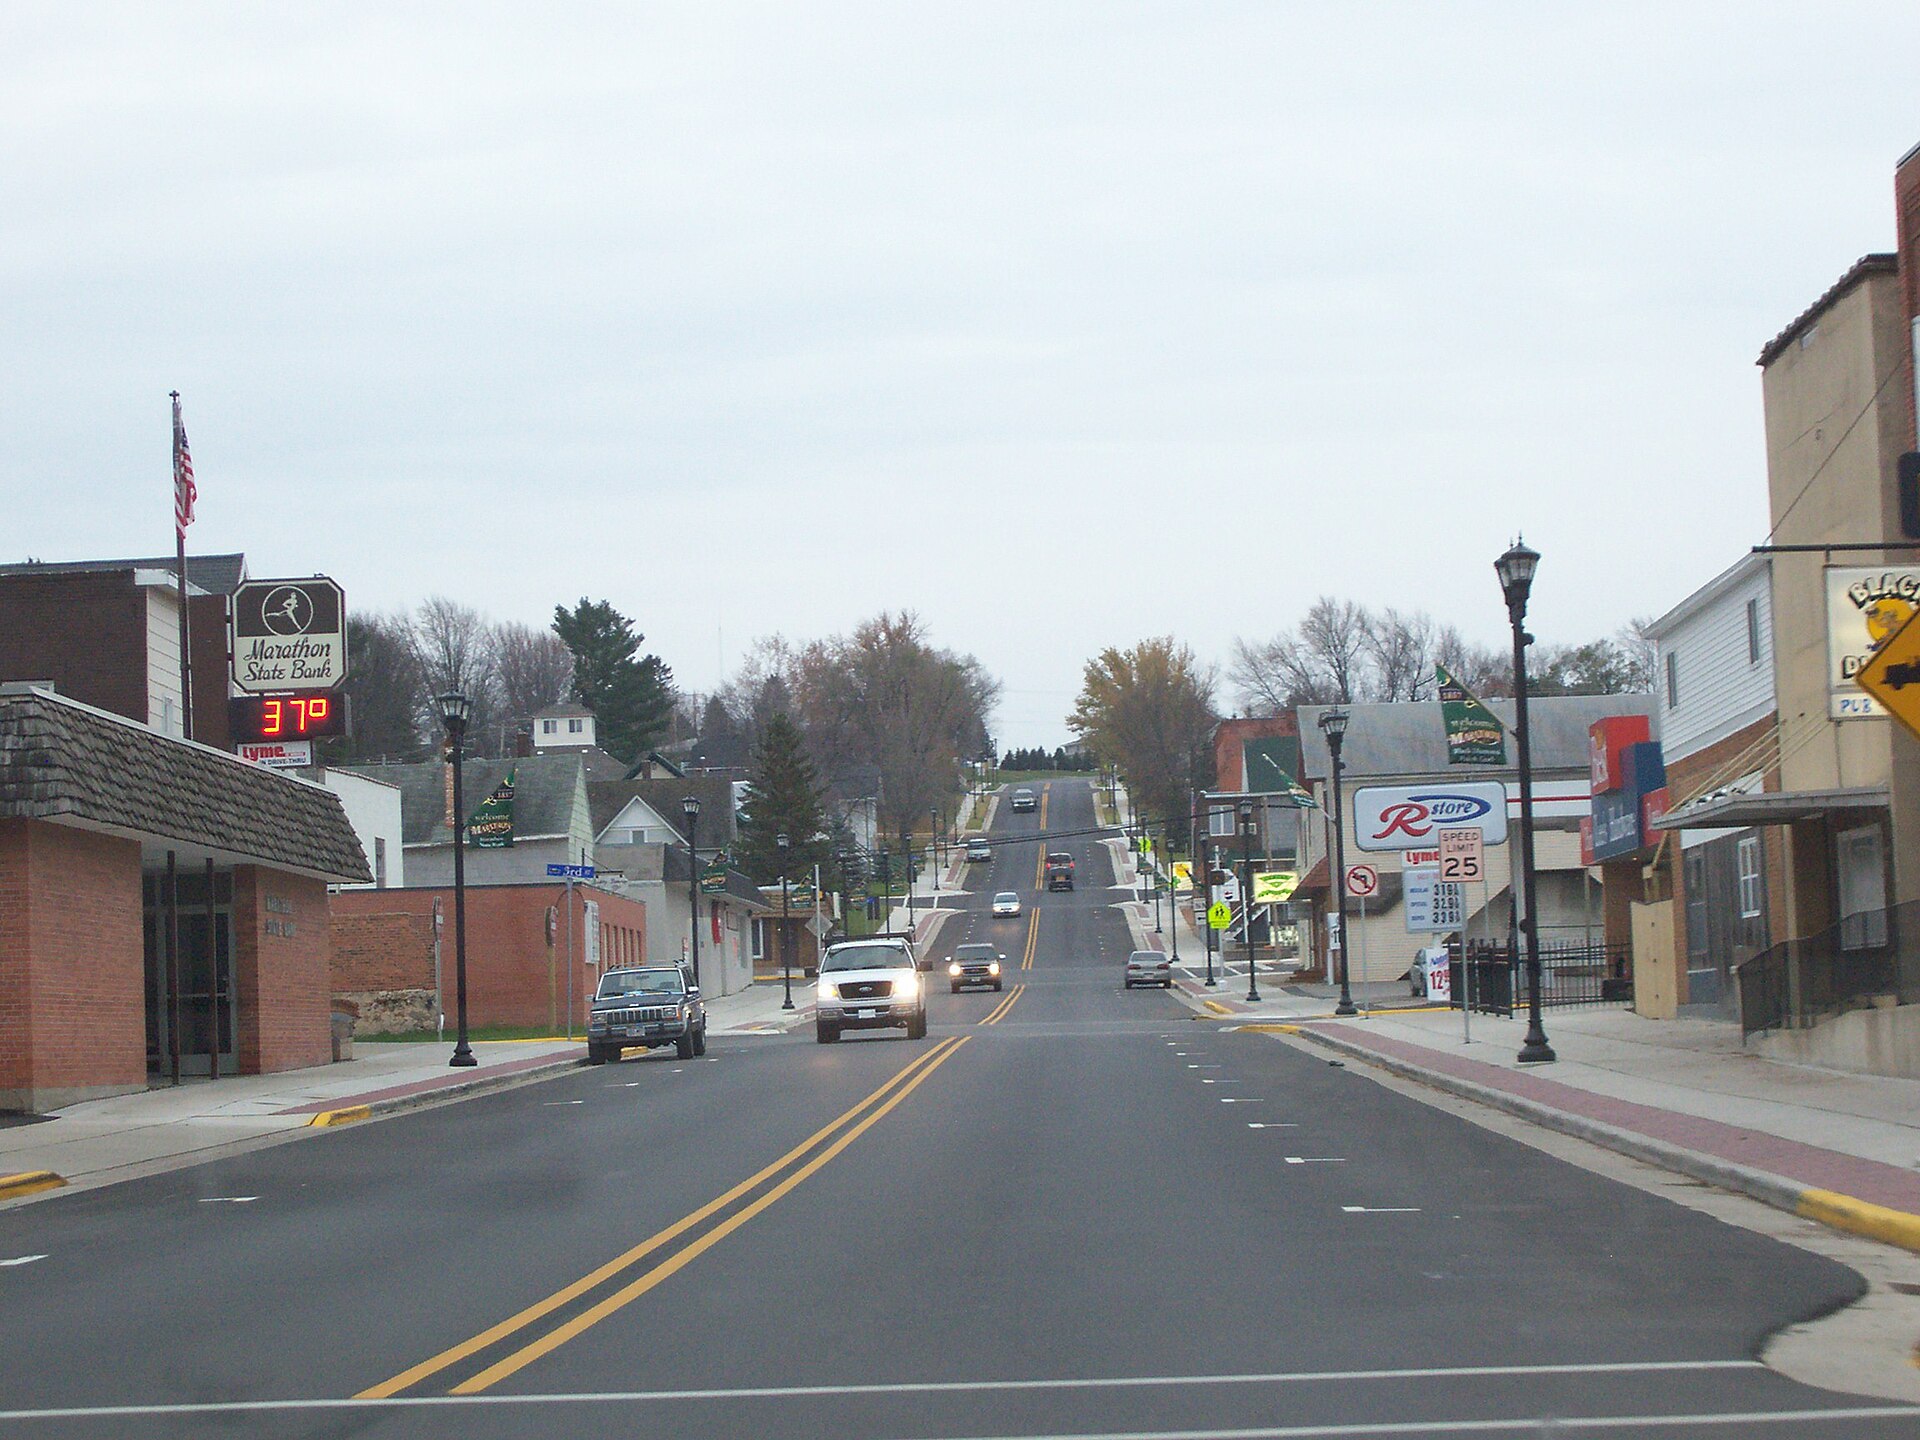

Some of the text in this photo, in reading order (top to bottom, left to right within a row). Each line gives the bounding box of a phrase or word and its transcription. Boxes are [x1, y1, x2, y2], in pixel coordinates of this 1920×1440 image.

[243, 637, 331, 661] Marathon
[243, 658, 332, 682] State Bank
[1371, 798, 1473, 839] R store
[1442, 831, 1480, 842] SPEED
[1446, 843, 1475, 854] LIMIT
[563, 866, 582, 877] 3rd
[1444, 857, 1480, 879] 25
